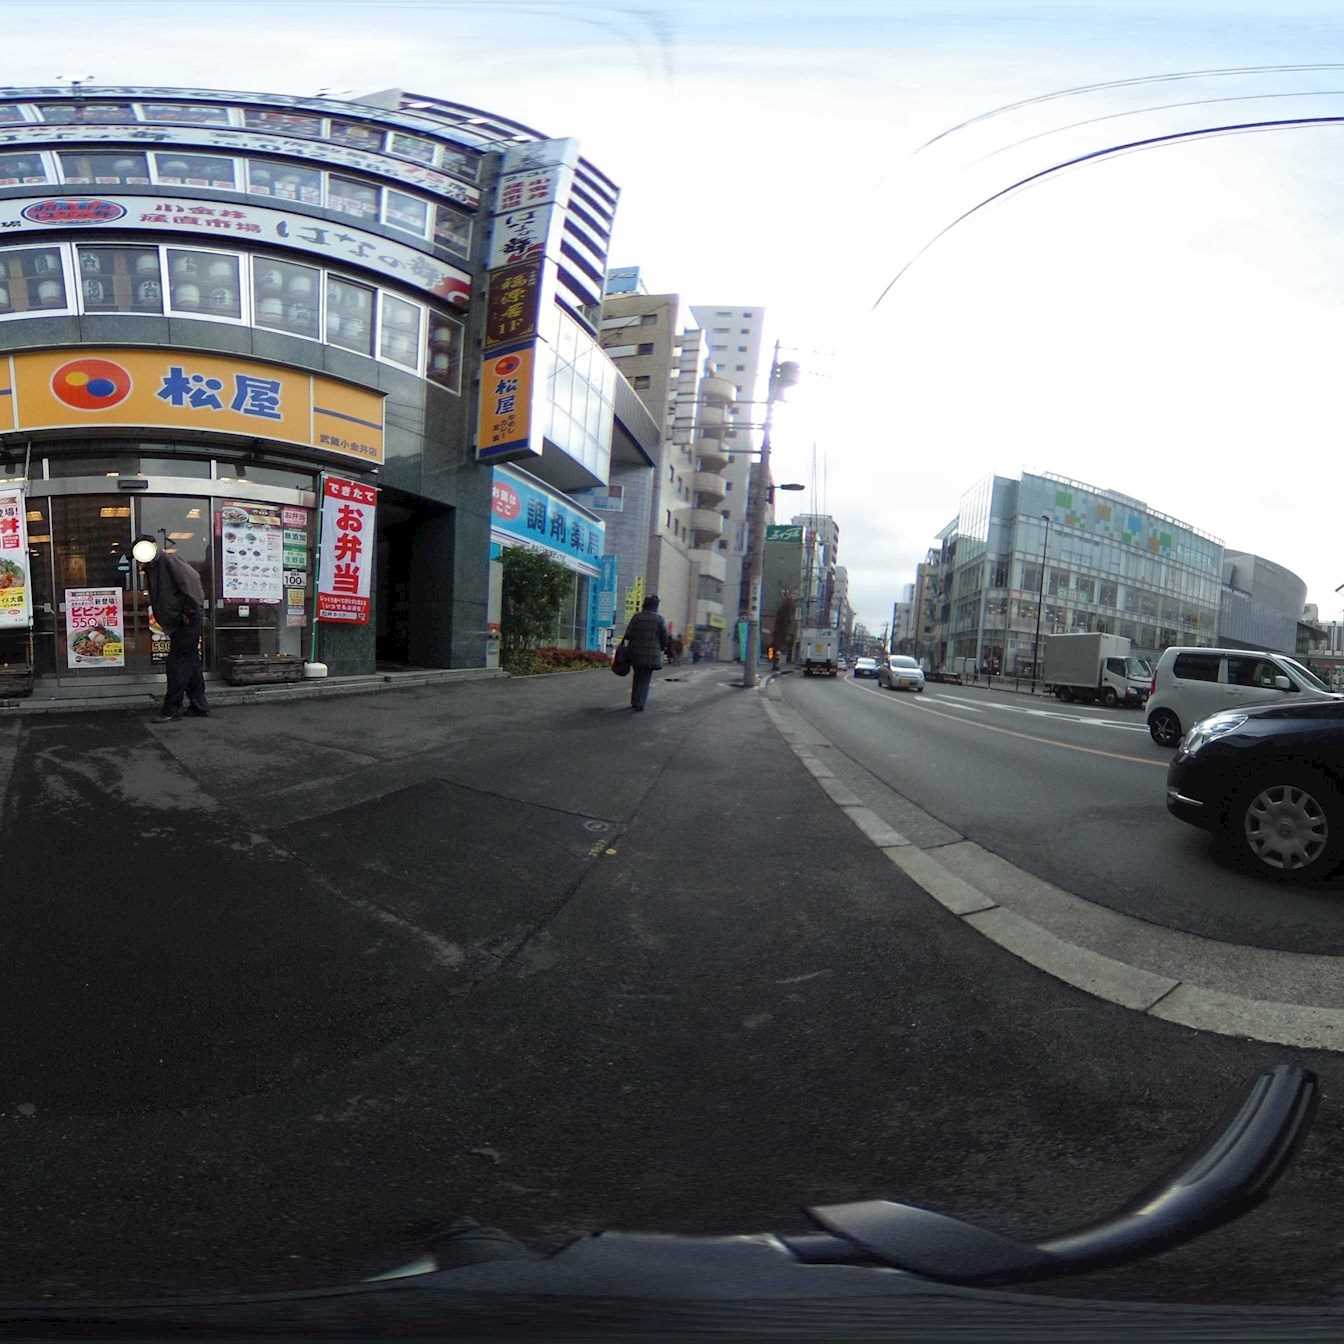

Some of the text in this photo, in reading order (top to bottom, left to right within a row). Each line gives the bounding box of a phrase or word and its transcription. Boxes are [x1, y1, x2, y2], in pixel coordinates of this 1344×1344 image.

[158, 366, 284, 422] 松屋
[496, 379, 518, 415] 松屋
[328, 482, 375, 502] できたて
[333, 504, 364, 594] お弁当
